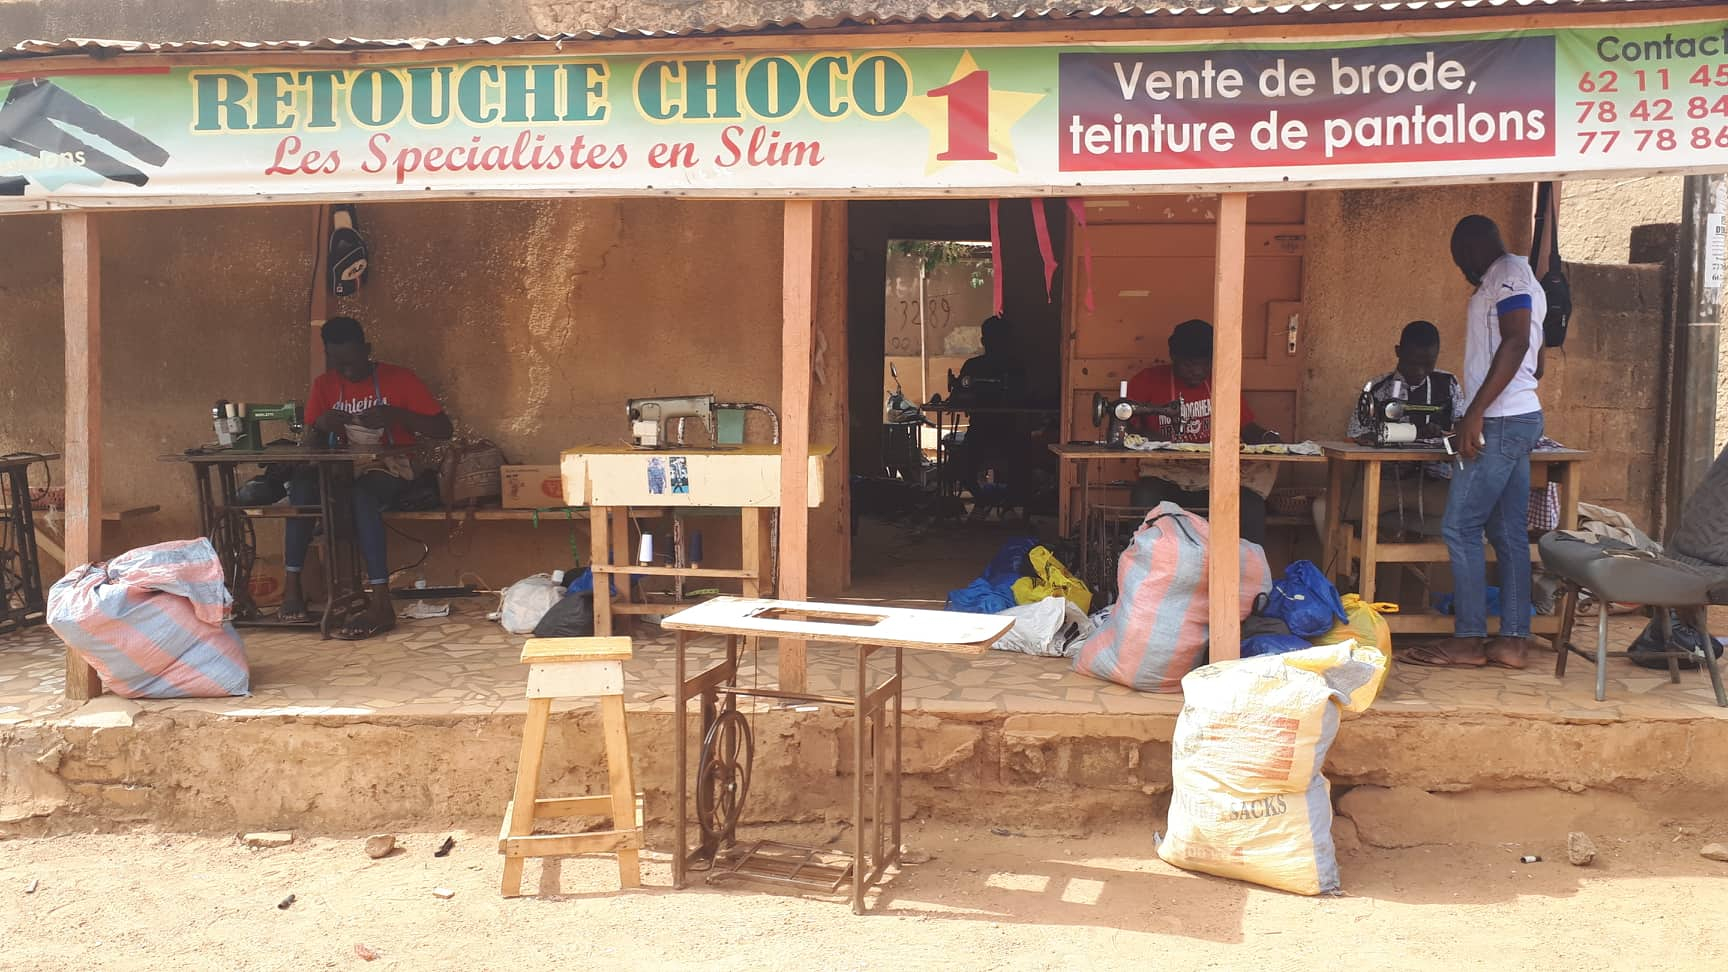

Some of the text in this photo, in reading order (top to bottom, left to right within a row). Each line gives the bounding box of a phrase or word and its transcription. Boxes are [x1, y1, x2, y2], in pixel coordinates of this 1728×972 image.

[189, 50, 914, 134] RETOUCHE CHOCO
[1113, 51, 1478, 101] Vente de brode,
[1578, 63, 1728, 93] 62 11 45
[926, 70, 998, 161] 1
[1069, 103, 1546, 157] teinture de pantalons
[1575, 94, 1728, 124] 78 42 84
[264, 124, 826, 183] Les Specialistes en Slim
[1577, 125, 1728, 154] 77 78 86
[1230, 792, 1287, 821] SACKS
